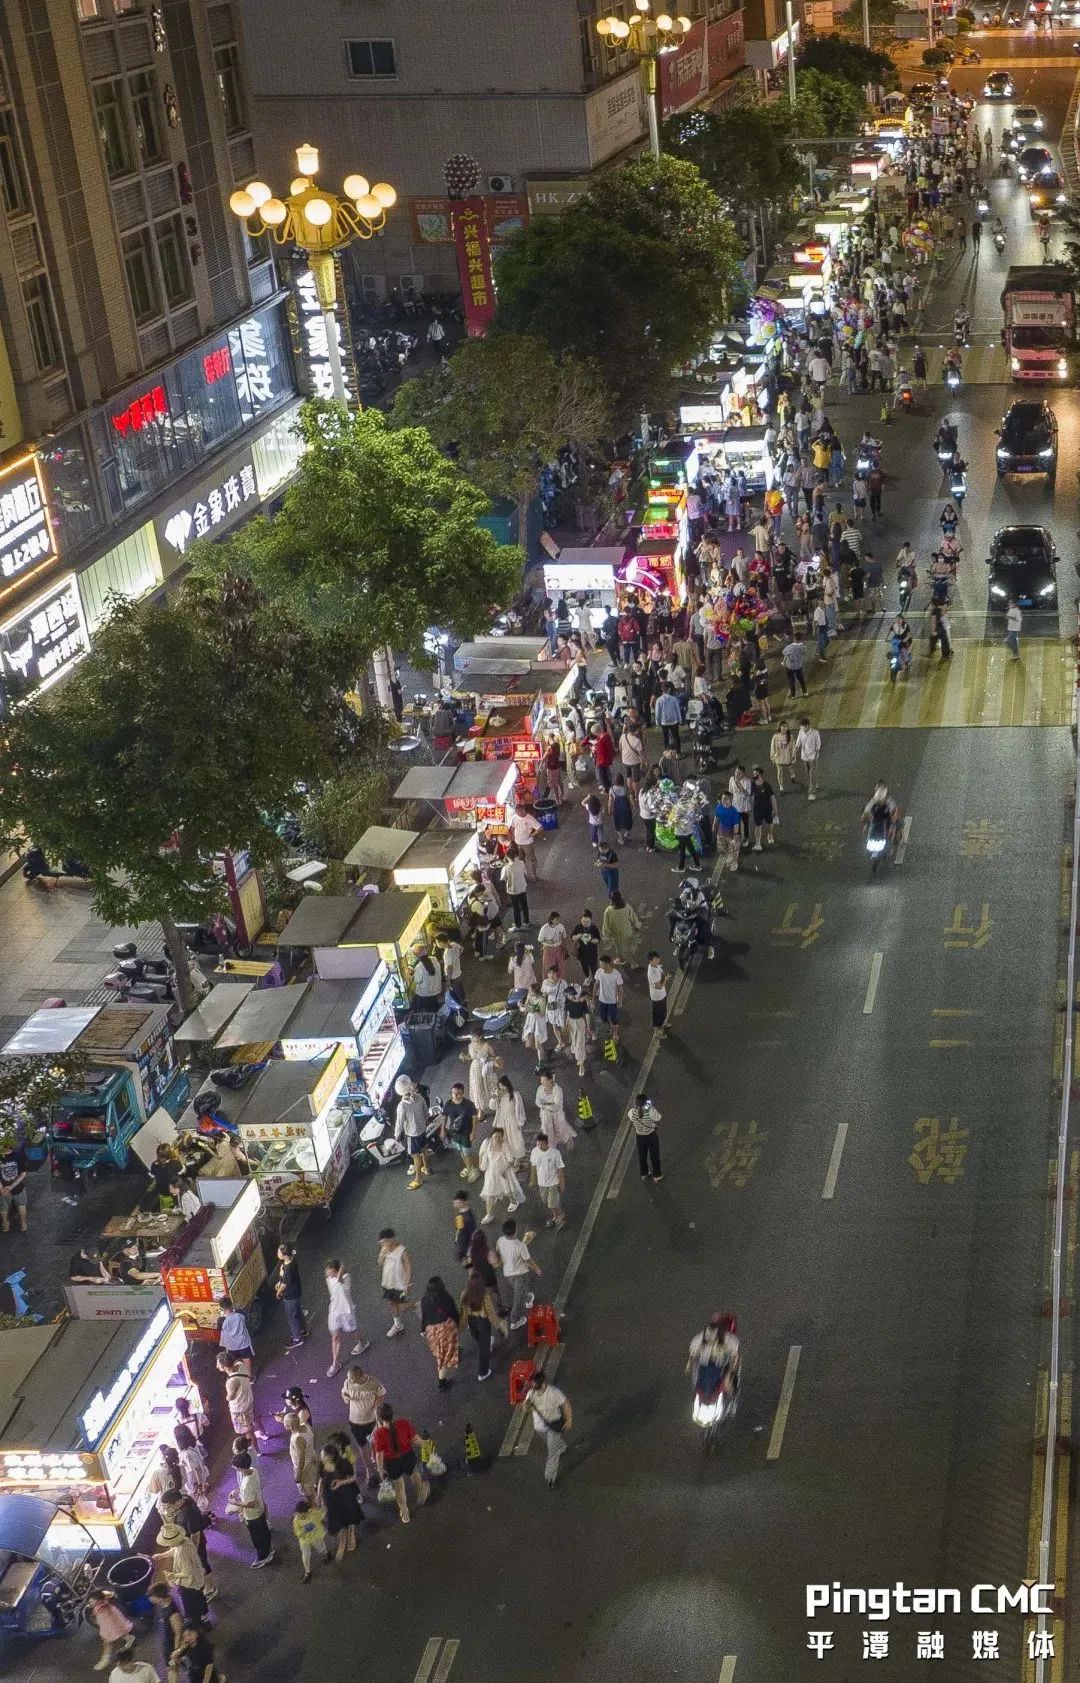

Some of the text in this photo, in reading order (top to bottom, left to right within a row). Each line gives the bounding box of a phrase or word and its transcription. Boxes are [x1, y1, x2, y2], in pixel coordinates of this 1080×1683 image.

[463, 224, 488, 306] 兴福兴超市
[193, 464, 257, 538] 金象珠寶
